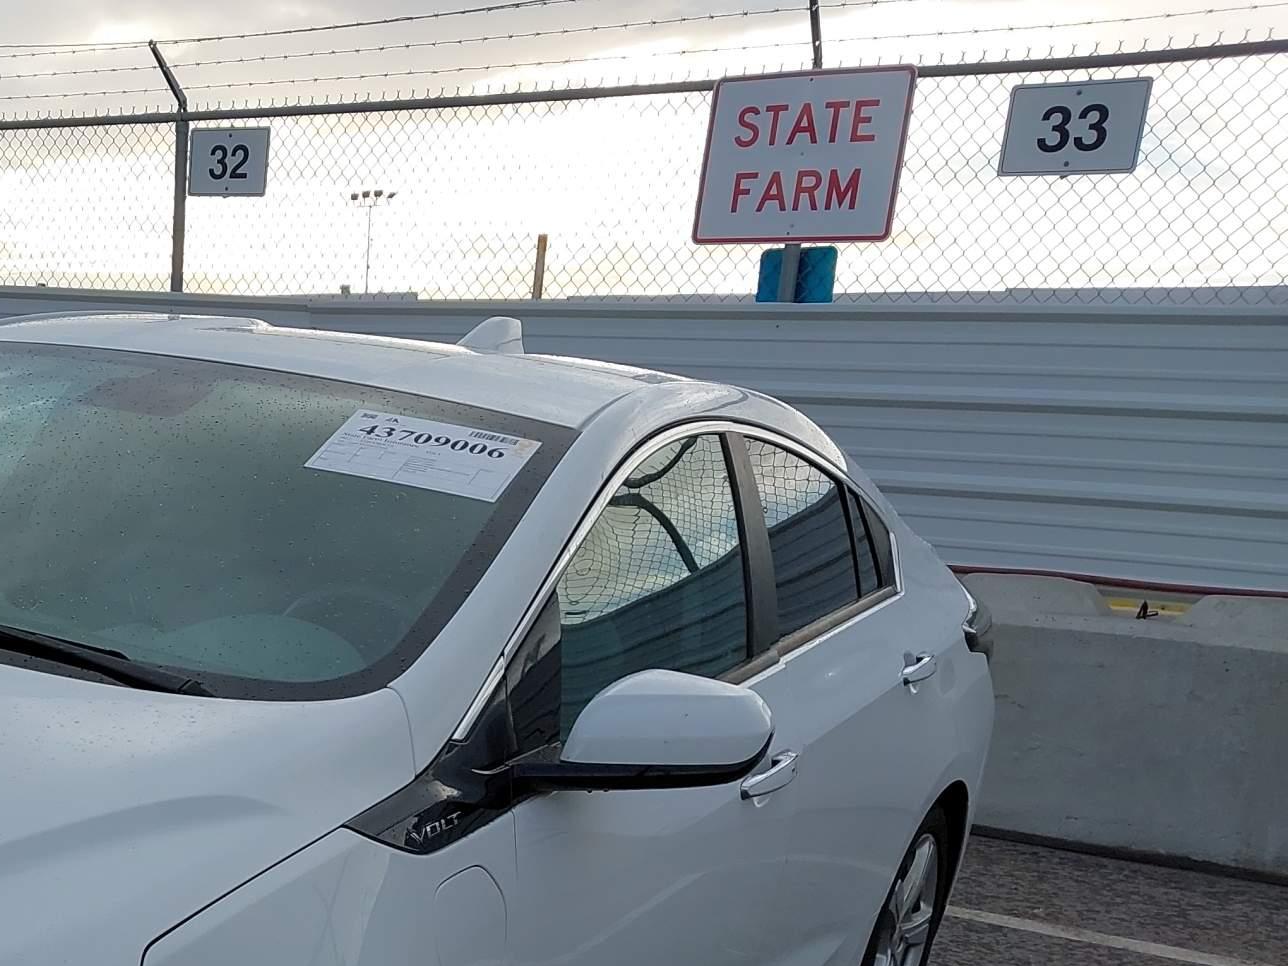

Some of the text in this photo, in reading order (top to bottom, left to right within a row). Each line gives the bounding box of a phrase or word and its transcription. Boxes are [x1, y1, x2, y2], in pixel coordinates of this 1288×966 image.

[733, 98, 881, 149] STATE
[1036, 103, 1110, 154] 33
[208, 143, 250, 180] 32
[730, 167, 861, 213] FARM
[358, 424, 509, 459] 43709006
[409, 811, 463, 844] VOLT
